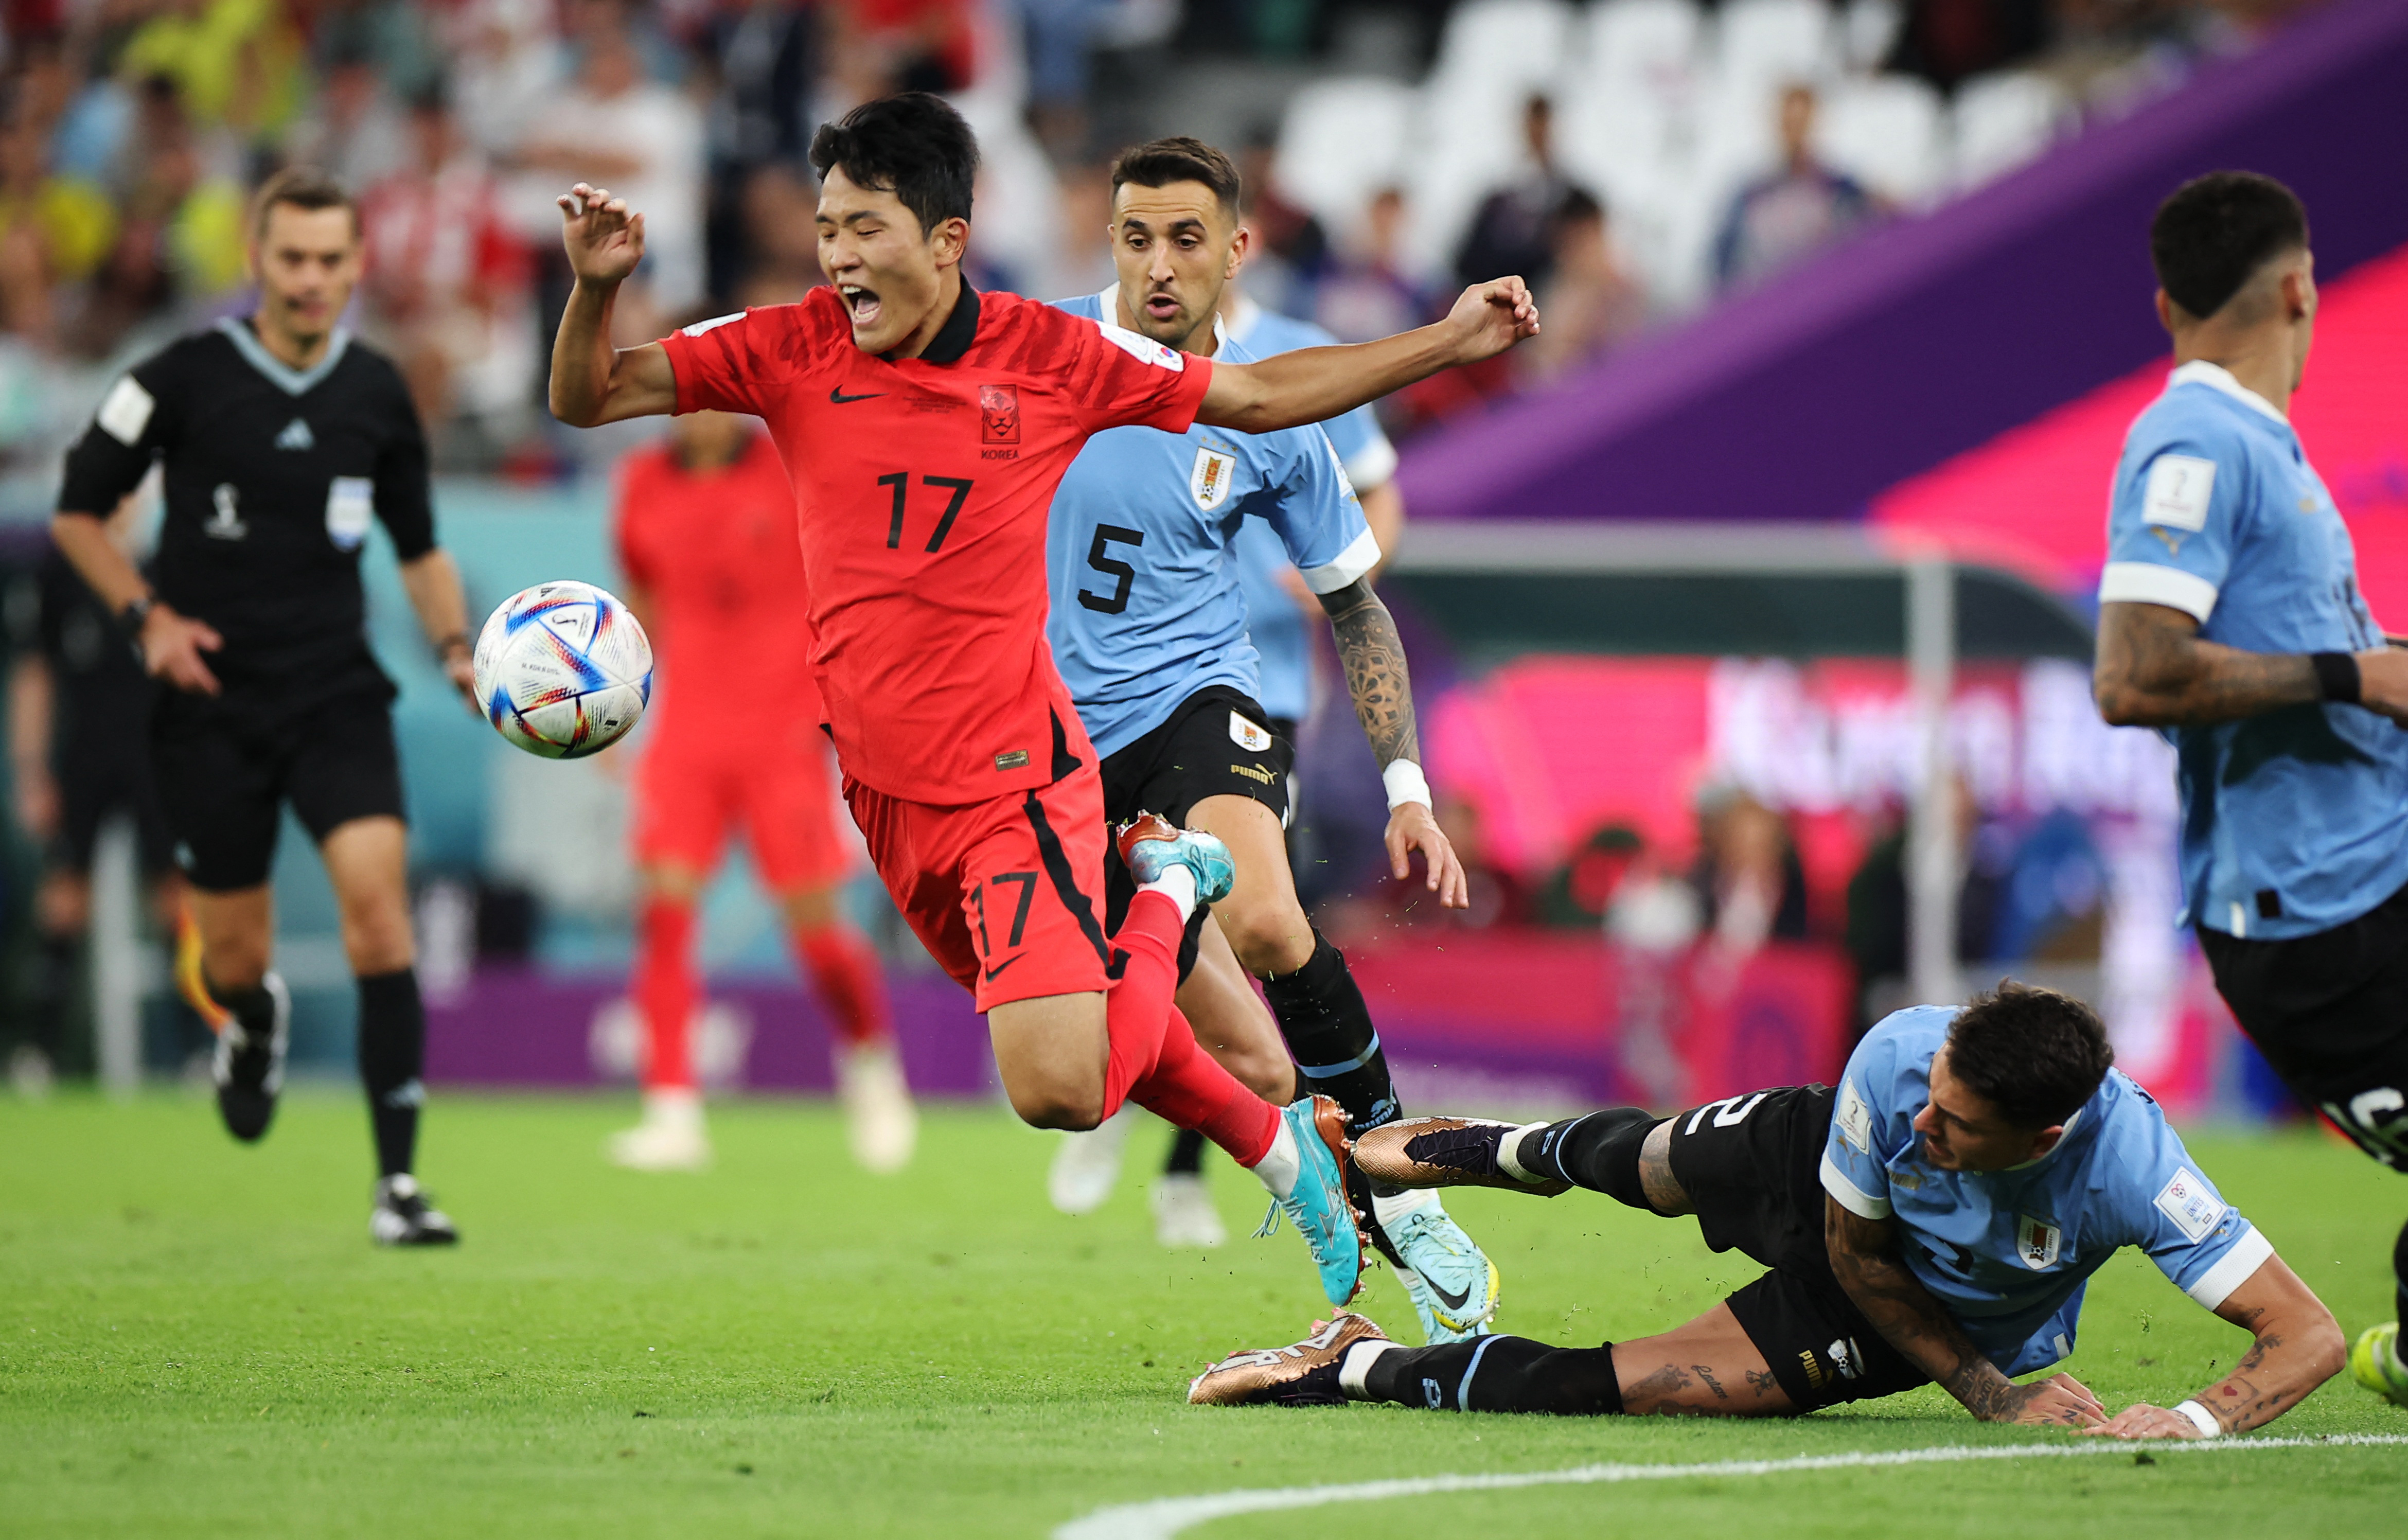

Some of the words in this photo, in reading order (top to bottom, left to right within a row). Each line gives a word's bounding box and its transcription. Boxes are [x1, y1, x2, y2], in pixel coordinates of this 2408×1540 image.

[981, 449, 1020, 460] KOREA
[877, 471, 974, 553] 17
[1077, 523, 1144, 615] 5
[1230, 764, 1269, 785] PUMA
[970, 871, 1039, 958] 17
[1684, 1092, 1768, 1136] 2
[2186, 1197, 2205, 1217] UNITES
[1798, 1349, 1824, 1389] PUMA
